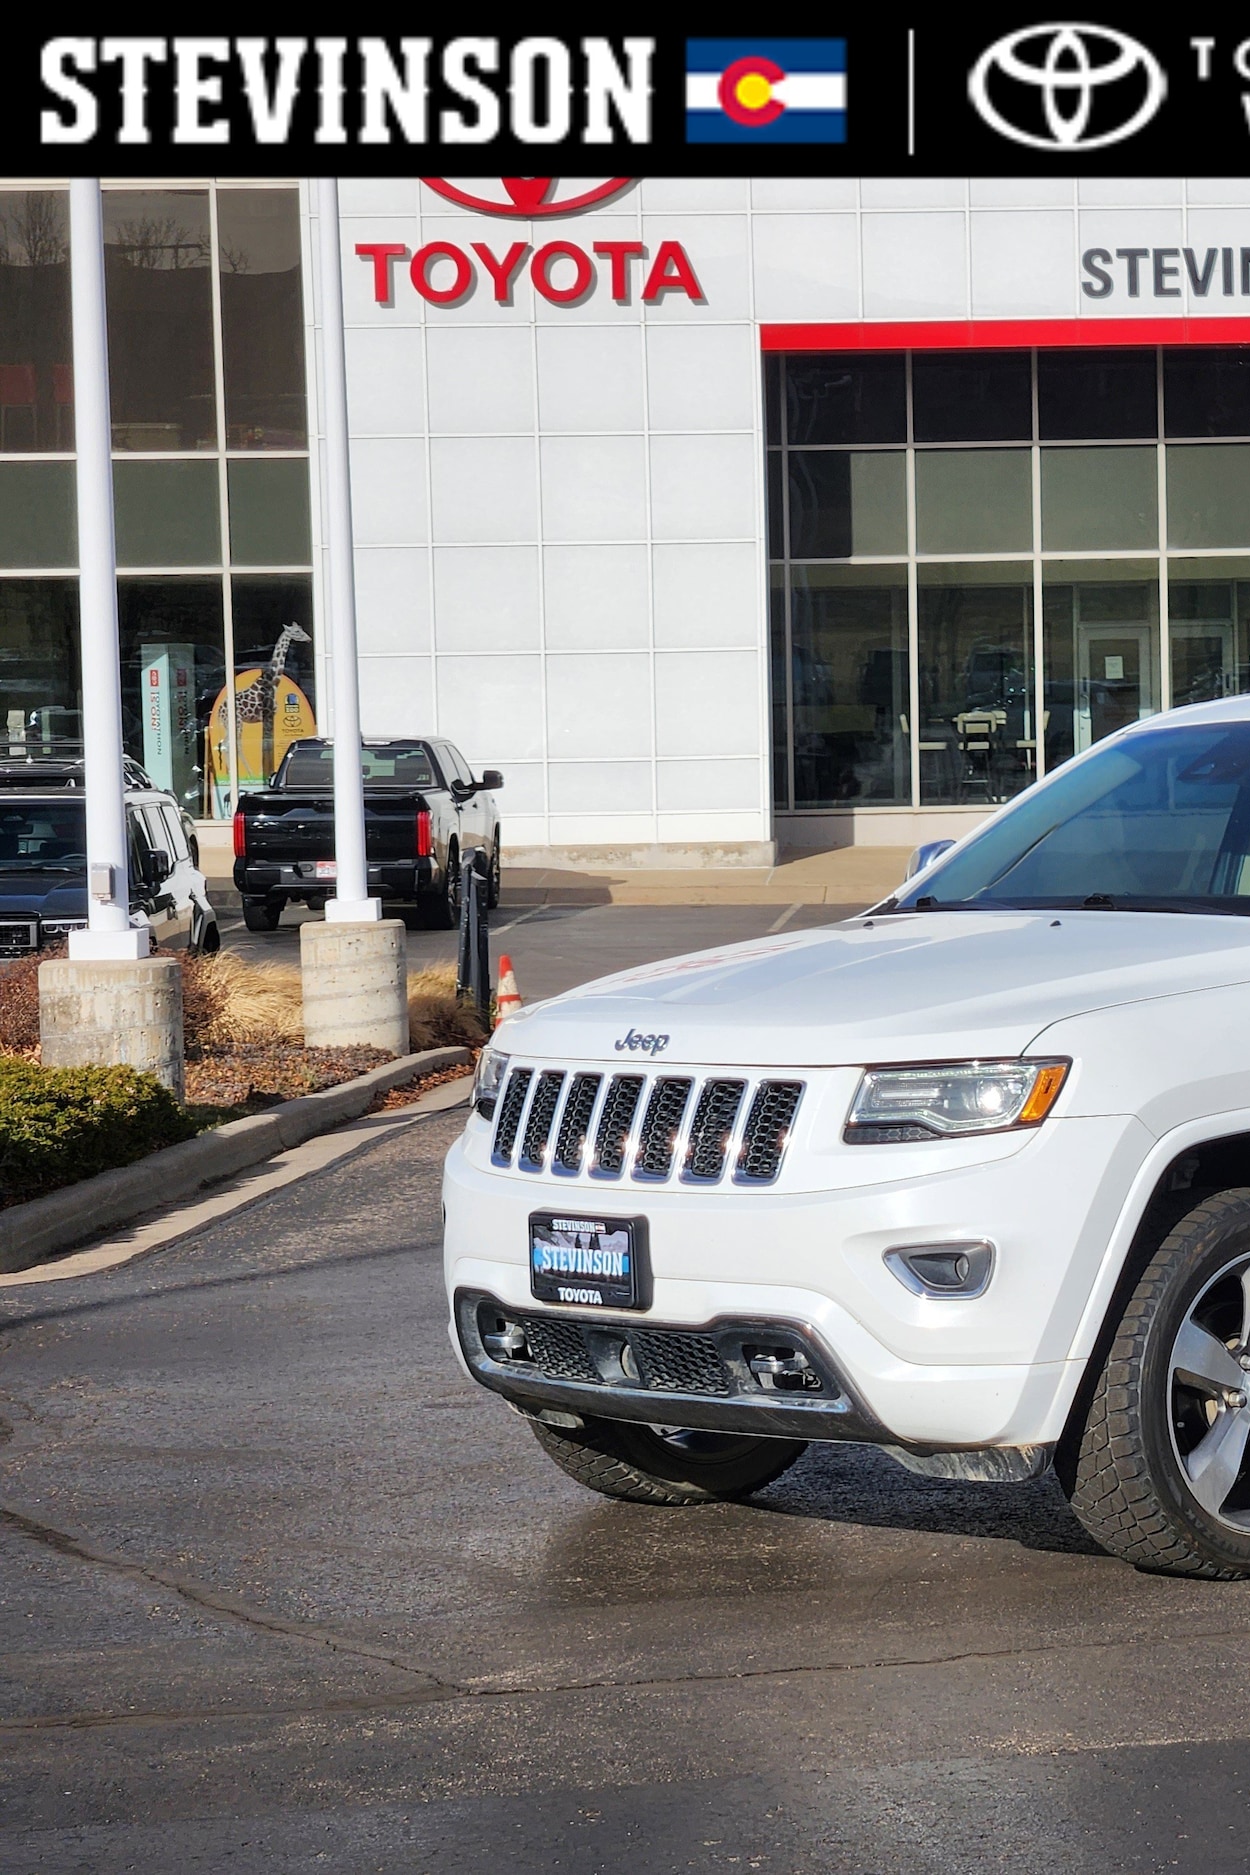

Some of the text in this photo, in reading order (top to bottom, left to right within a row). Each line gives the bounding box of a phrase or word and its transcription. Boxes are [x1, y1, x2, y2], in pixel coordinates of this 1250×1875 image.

[355, 240, 705, 306] TOYOTA
[614, 1028, 670, 1057] Jeep
[551, 1218, 595, 1233] STEVINSON
[541, 1246, 623, 1277] STEVINSON
[557, 1286, 603, 1305] TOYOTA
